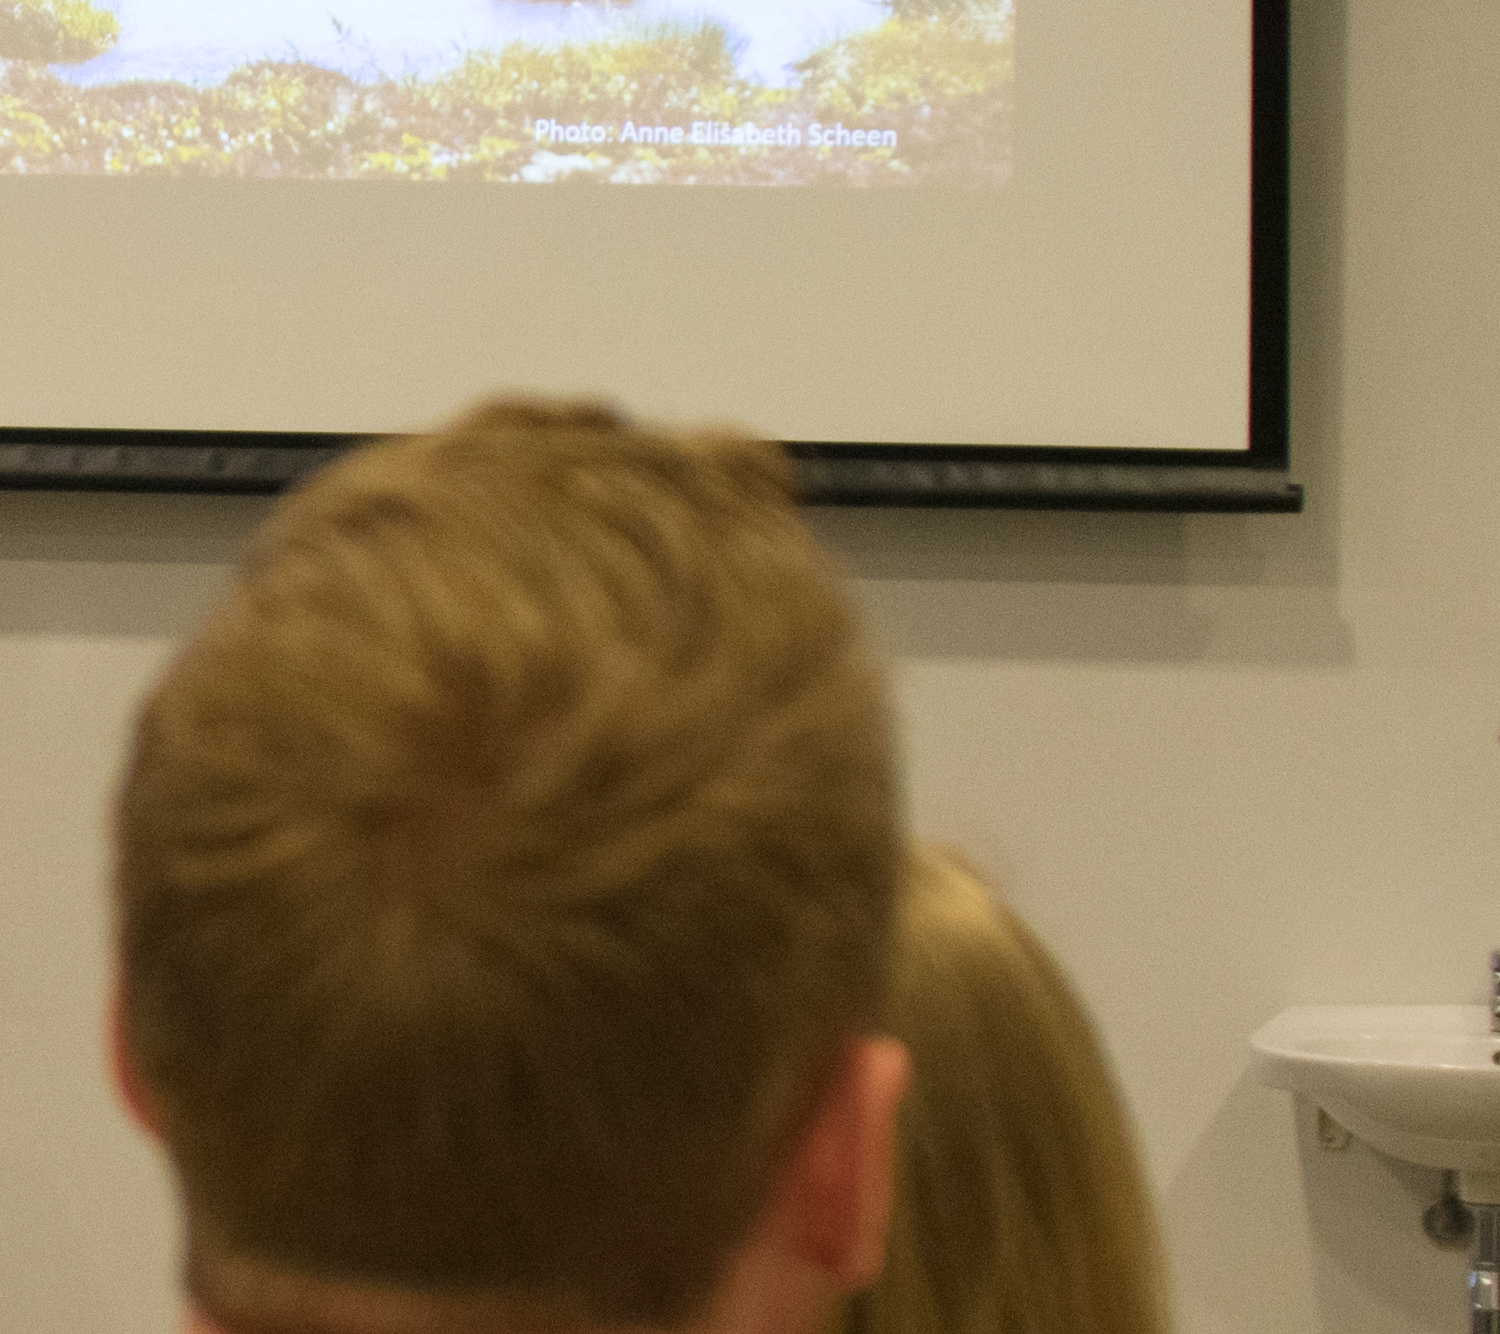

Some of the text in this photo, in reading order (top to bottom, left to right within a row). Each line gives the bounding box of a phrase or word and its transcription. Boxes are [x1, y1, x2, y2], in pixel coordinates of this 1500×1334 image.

[533, 118, 898, 148] Photo: Anne Elisabeth Scheen
